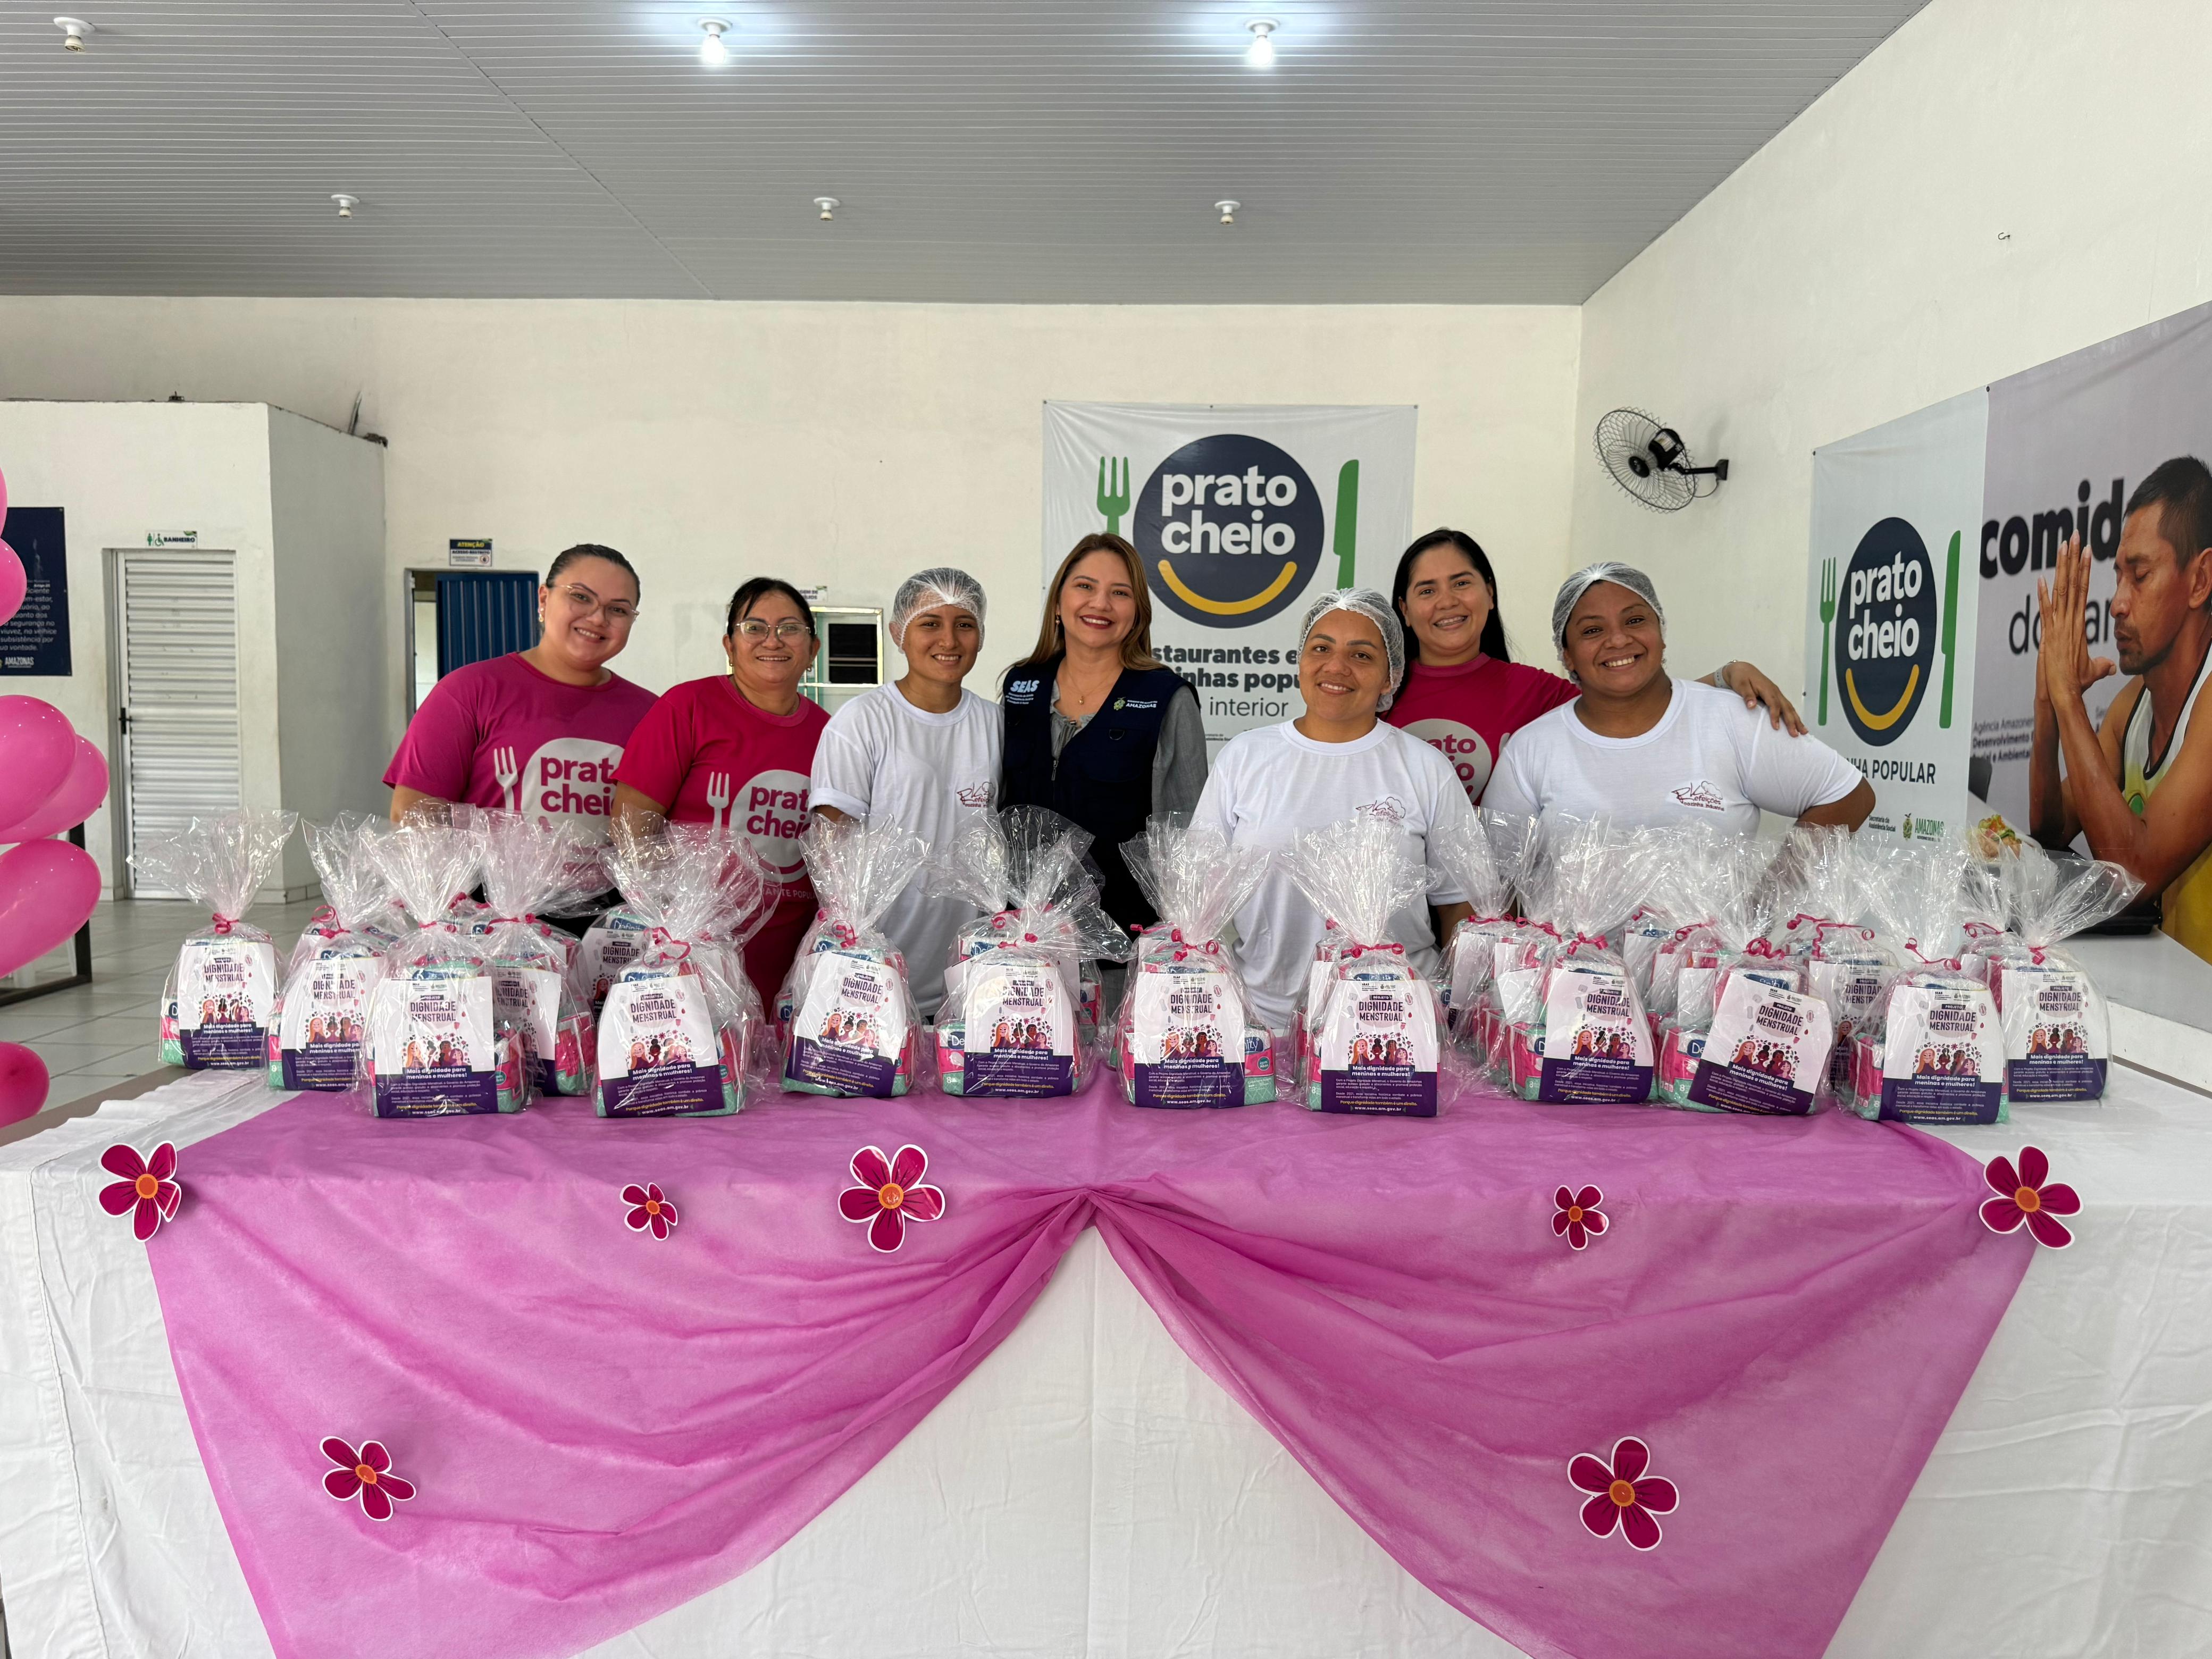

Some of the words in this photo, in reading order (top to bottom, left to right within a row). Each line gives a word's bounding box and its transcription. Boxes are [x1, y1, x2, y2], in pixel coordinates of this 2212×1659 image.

[1161, 465, 1297, 516] prato
[1161, 510, 1295, 555] cheio
[1849, 551, 1922, 619] prato
[1848, 604, 1919, 660] cheio
[5, 657, 34, 665] AMAZONAS
[1010, 680, 1040, 692] SEAS
[1210, 697, 1288, 716] interior
[540, 756, 615, 786] prat
[1872, 760, 1936, 784] POPULAR
[540, 783, 615, 816] chei
[748, 786, 810, 812] prat
[1915, 818, 1944, 837] AMAZONAS
[843, 977, 883, 994] DIGNIDADE
[841, 988, 878, 1004] MENSTRUAL
[1003, 998, 1043, 1006] MENSTRUAL
[1587, 994, 1630, 1007] DIGNIDADE
[2039, 992, 2081, 1001] DIGNIDADE
[631, 999, 676, 1013] DIGNIDADE
[1359, 1002, 1403, 1011] DIGNIDADE
[1587, 1004, 1629, 1017] MENSTRUAL
[632, 1010, 677, 1023] MENSTRUAL
[1360, 1012, 1403, 1021] MENSTRUAL
[1759, 1006, 1804, 1026] DIGNIDADE
[1930, 1010, 1976, 1021] DIGNIDADE
[1756, 1016, 1798, 1035] MENSTRUAL
[1930, 1021, 1974, 1032] MENSTRUAL
[1729, 1069, 1754, 1080] meninas
[1758, 1078, 1787, 1091] mulheres!
[1746, 1068, 1774, 1080] dignidade
